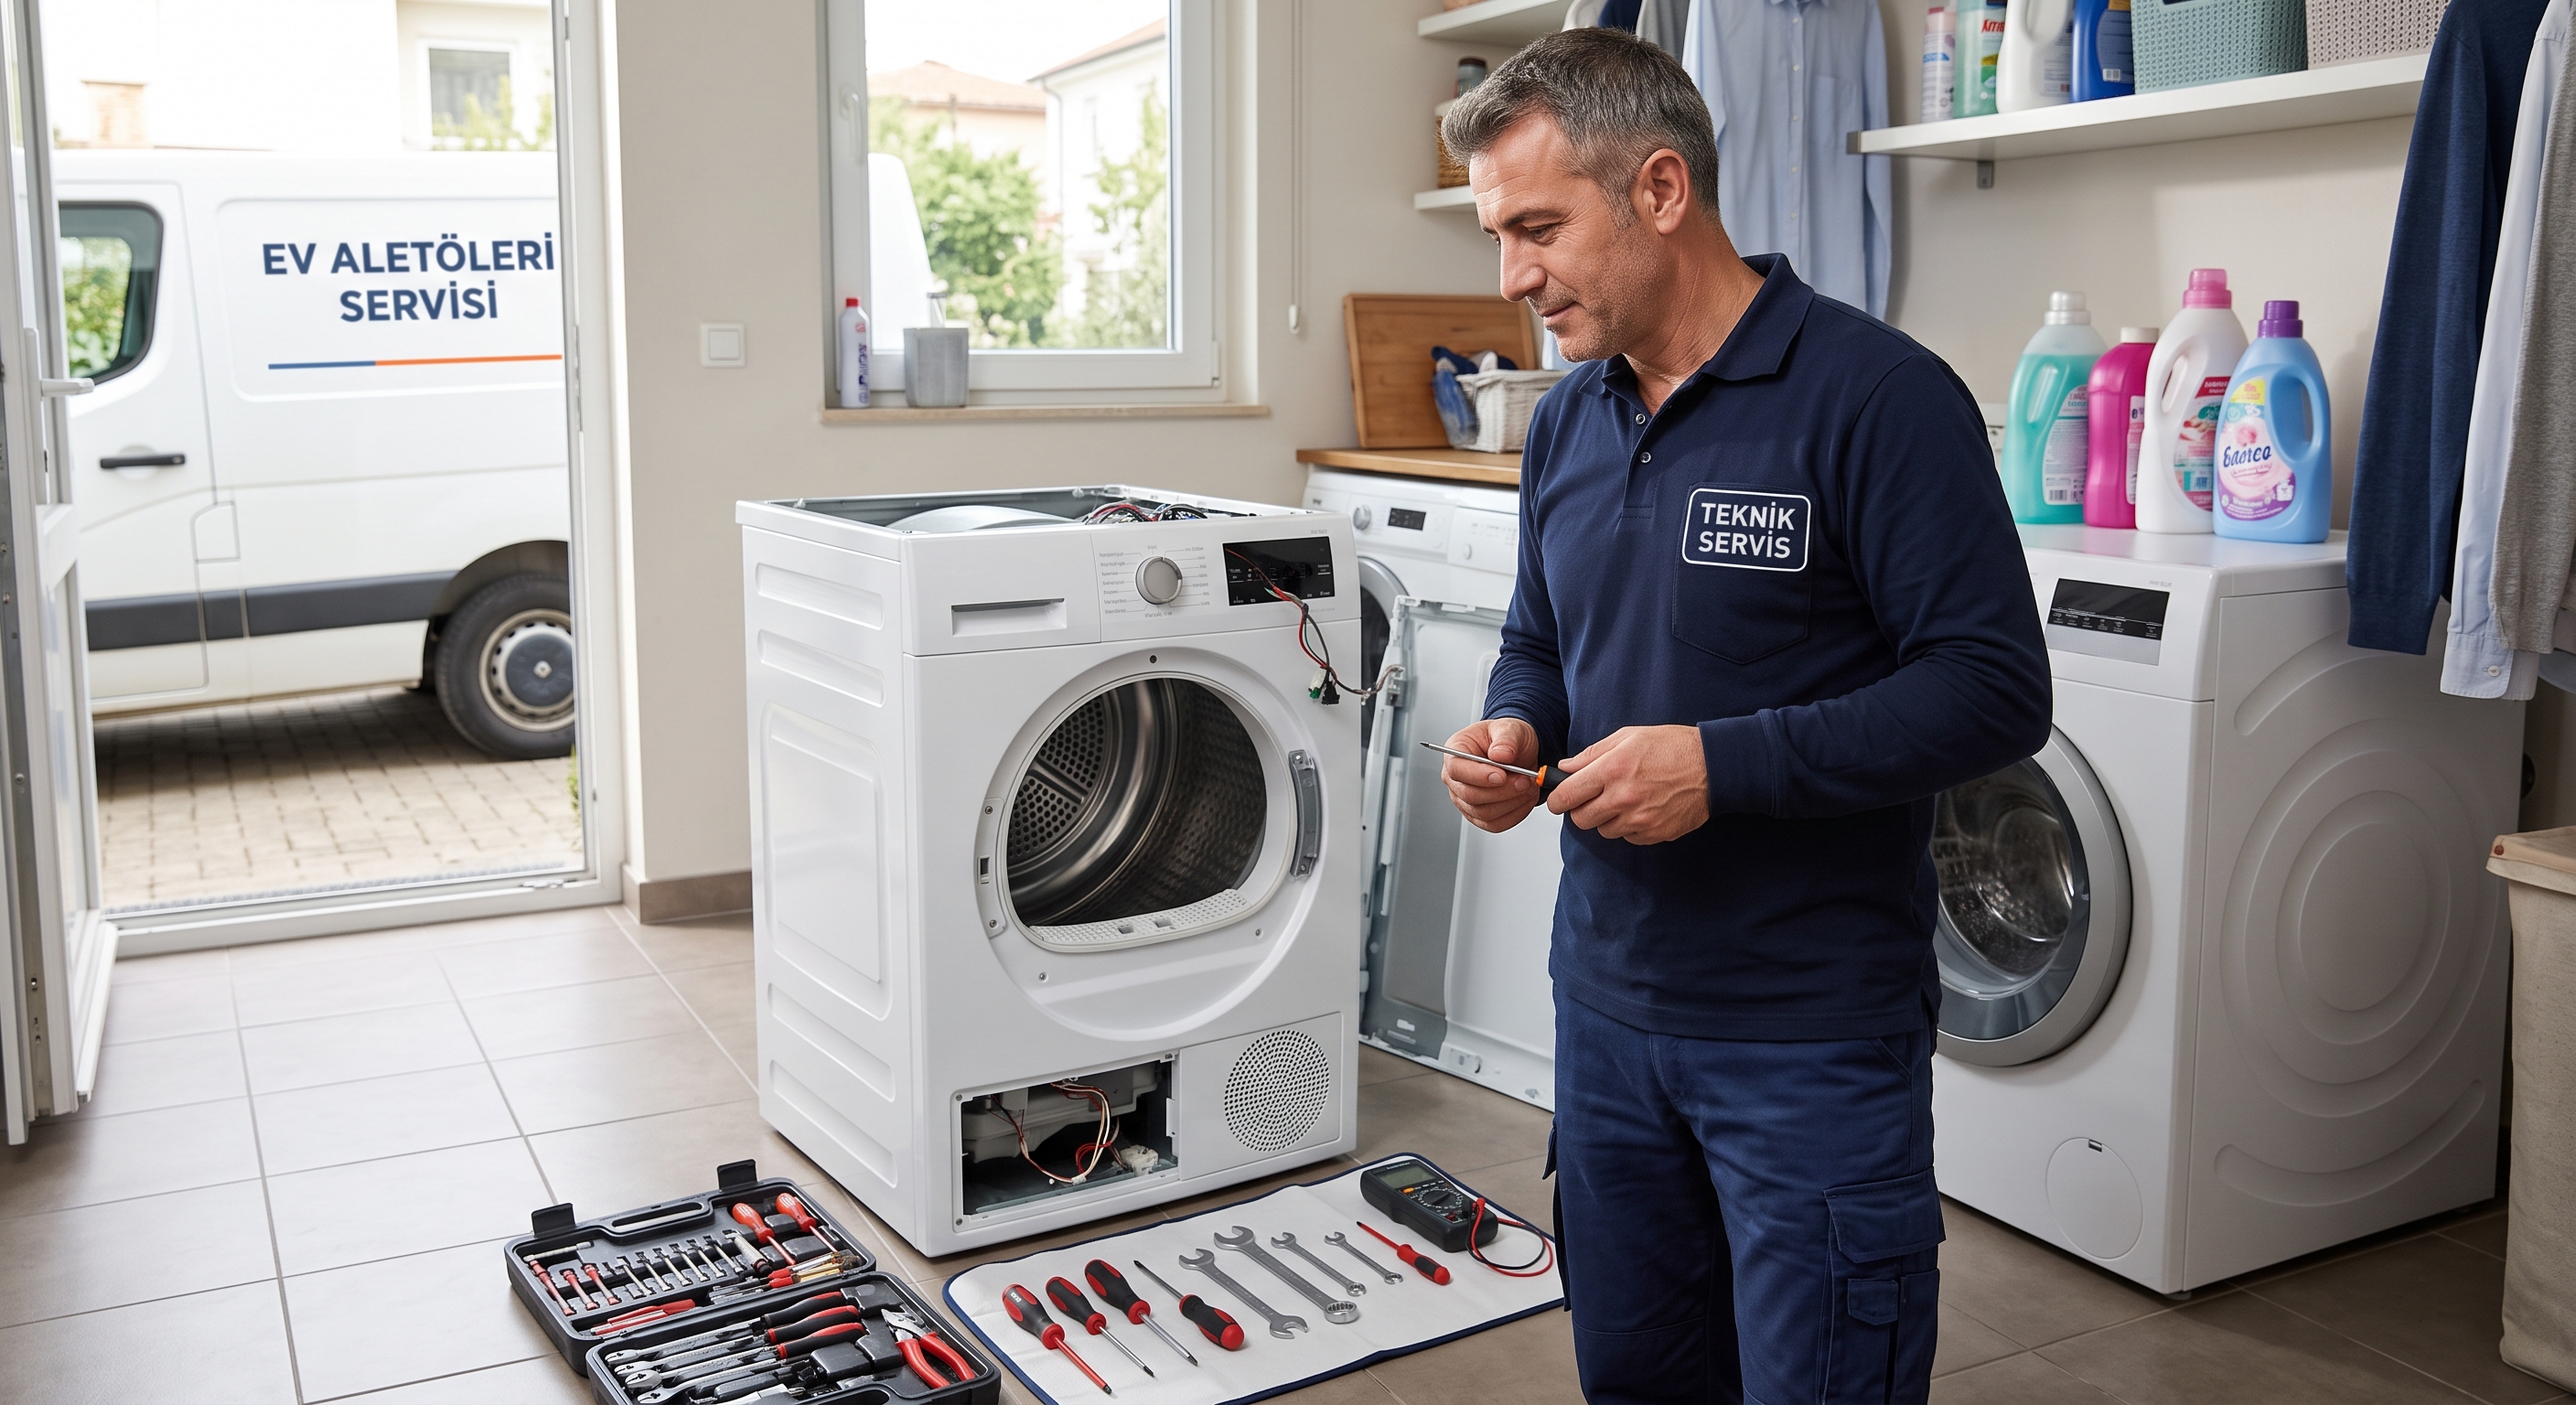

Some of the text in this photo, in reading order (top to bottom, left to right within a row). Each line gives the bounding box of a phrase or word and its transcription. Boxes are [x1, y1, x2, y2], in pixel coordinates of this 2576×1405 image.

[263, 232, 554, 274] EV ALETÖLERİ
[340, 280, 498, 322] SERVİSİ
[1701, 501, 1796, 531] TEKNİK
[1698, 531, 1791, 559] SERVİS
